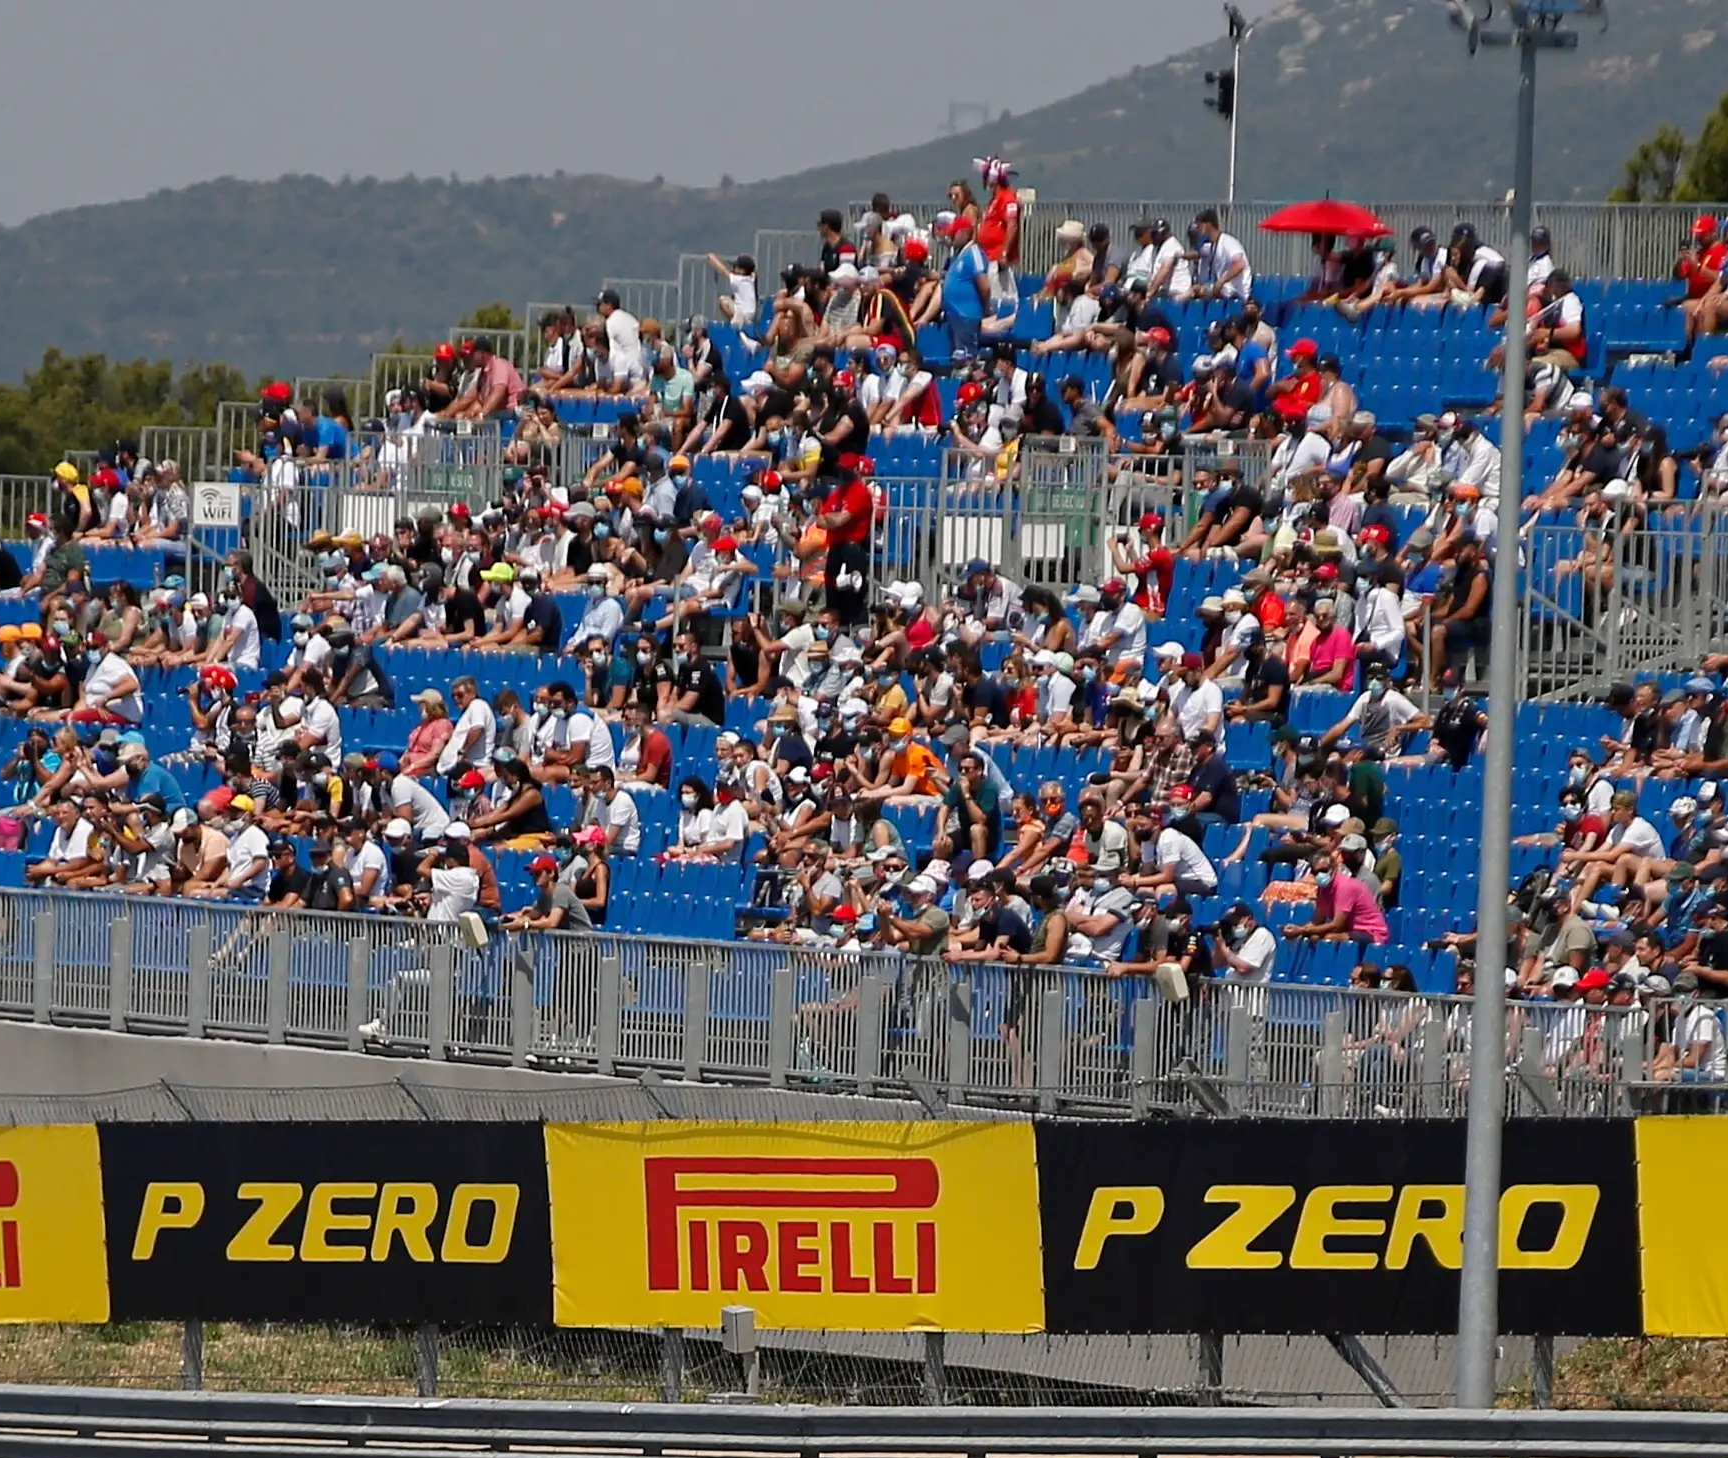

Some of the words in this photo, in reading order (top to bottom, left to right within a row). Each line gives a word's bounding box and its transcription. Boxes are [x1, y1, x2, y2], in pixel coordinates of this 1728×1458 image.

[132, 1181, 206, 1261] P
[227, 1181, 521, 1264] ZERO
[643, 1156, 940, 1295] PIRELLI
[1074, 1184, 1166, 1271] P
[1184, 1183, 1601, 1271] ZERO
